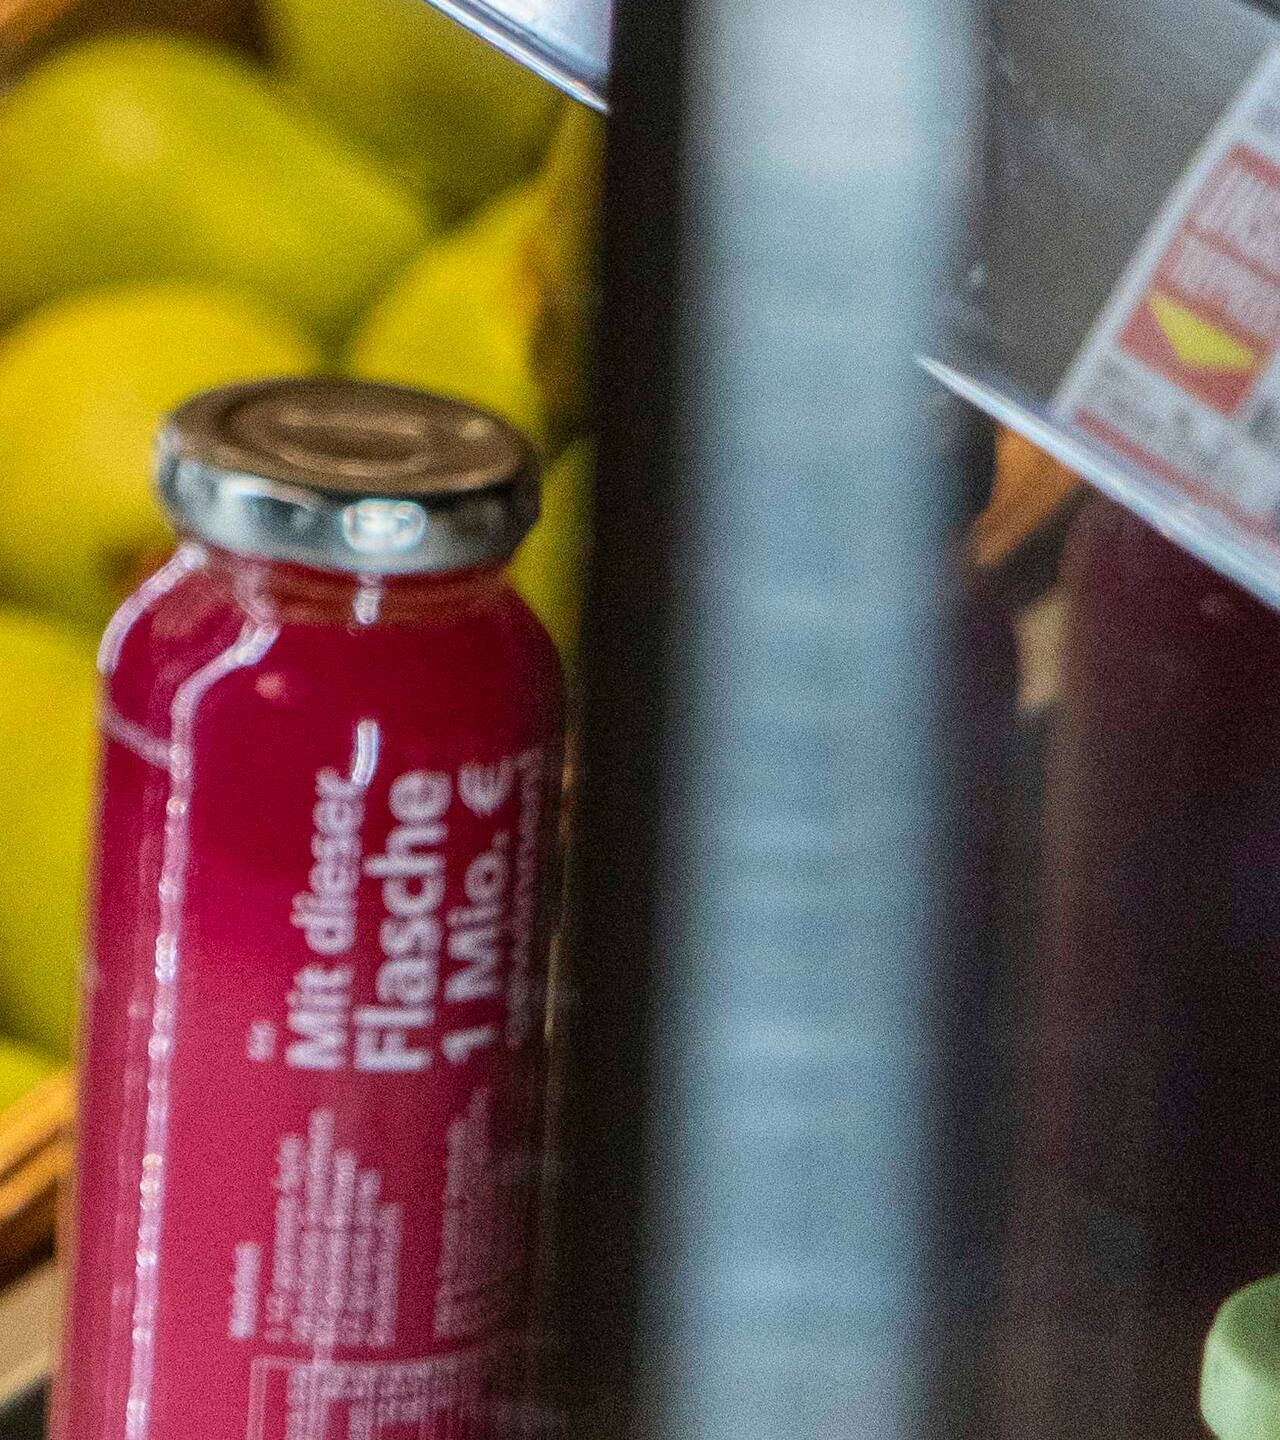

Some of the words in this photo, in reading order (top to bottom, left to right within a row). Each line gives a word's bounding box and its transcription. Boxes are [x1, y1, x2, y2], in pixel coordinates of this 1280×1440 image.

[289, 766, 367, 957] dieser
[353, 769, 453, 1072] Flasche
[442, 829, 513, 1004] Mio.
[285, 963, 354, 1071] Mit
[441, 1024, 496, 1065] 1
